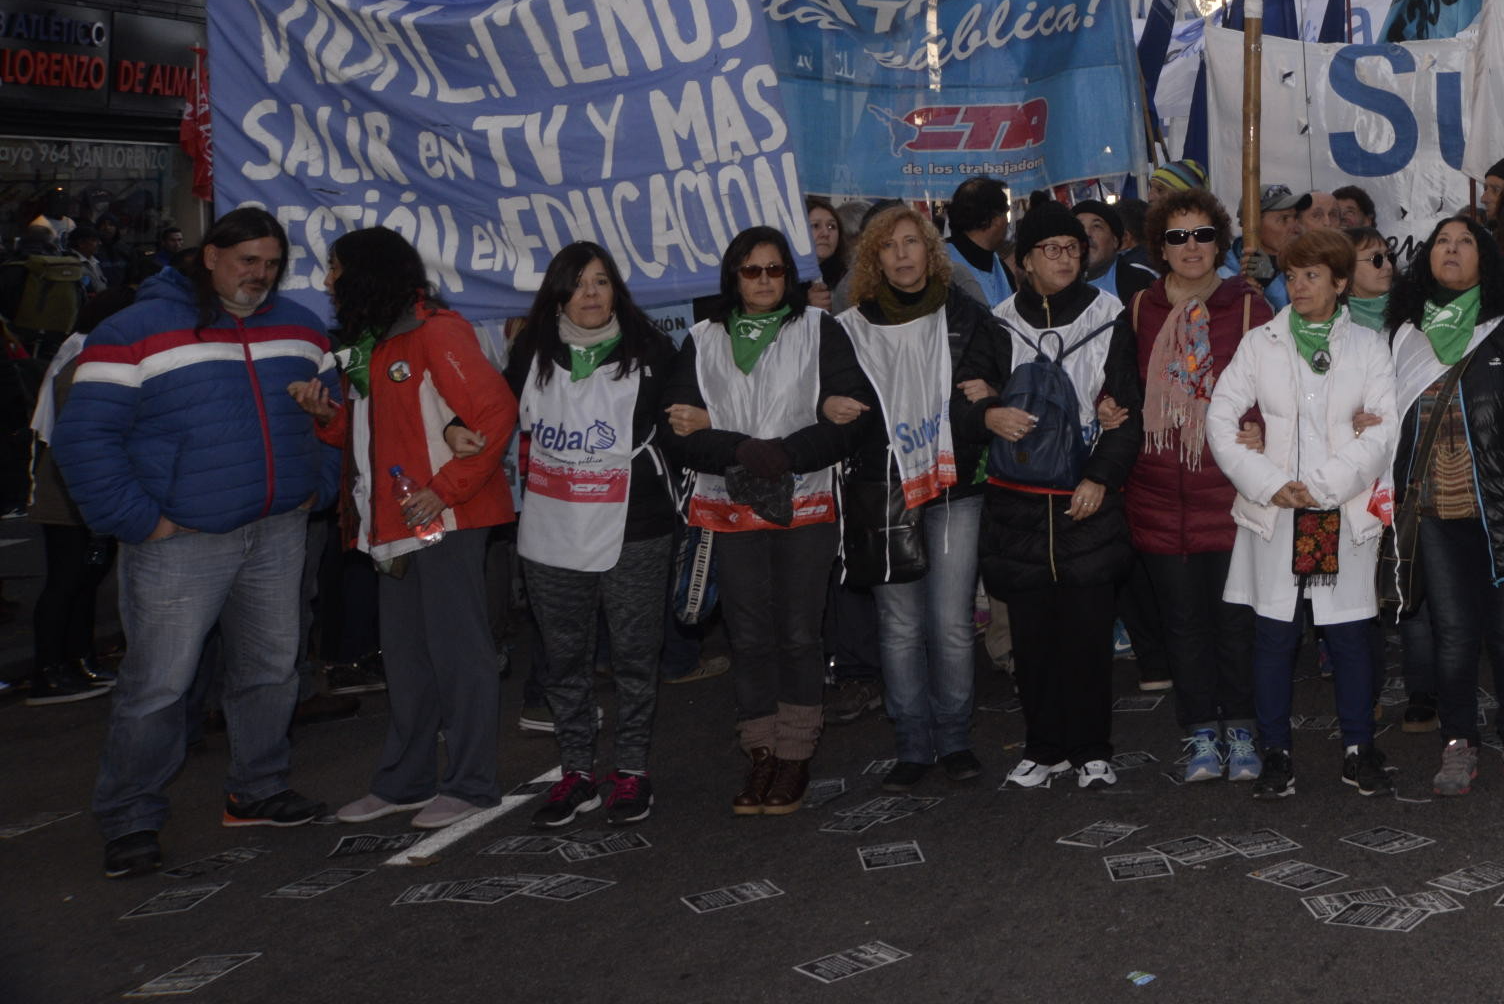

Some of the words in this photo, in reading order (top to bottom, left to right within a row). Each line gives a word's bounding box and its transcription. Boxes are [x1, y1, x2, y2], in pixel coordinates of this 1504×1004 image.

[1, 49, 106, 91] LORENZO
[117, 60, 146, 93] DE
[472, 104, 569, 188] TV
[586, 93, 625, 179] Y
[649, 57, 789, 171] MÁS
[902, 163, 923, 175] de
[928, 163, 953, 175] los
